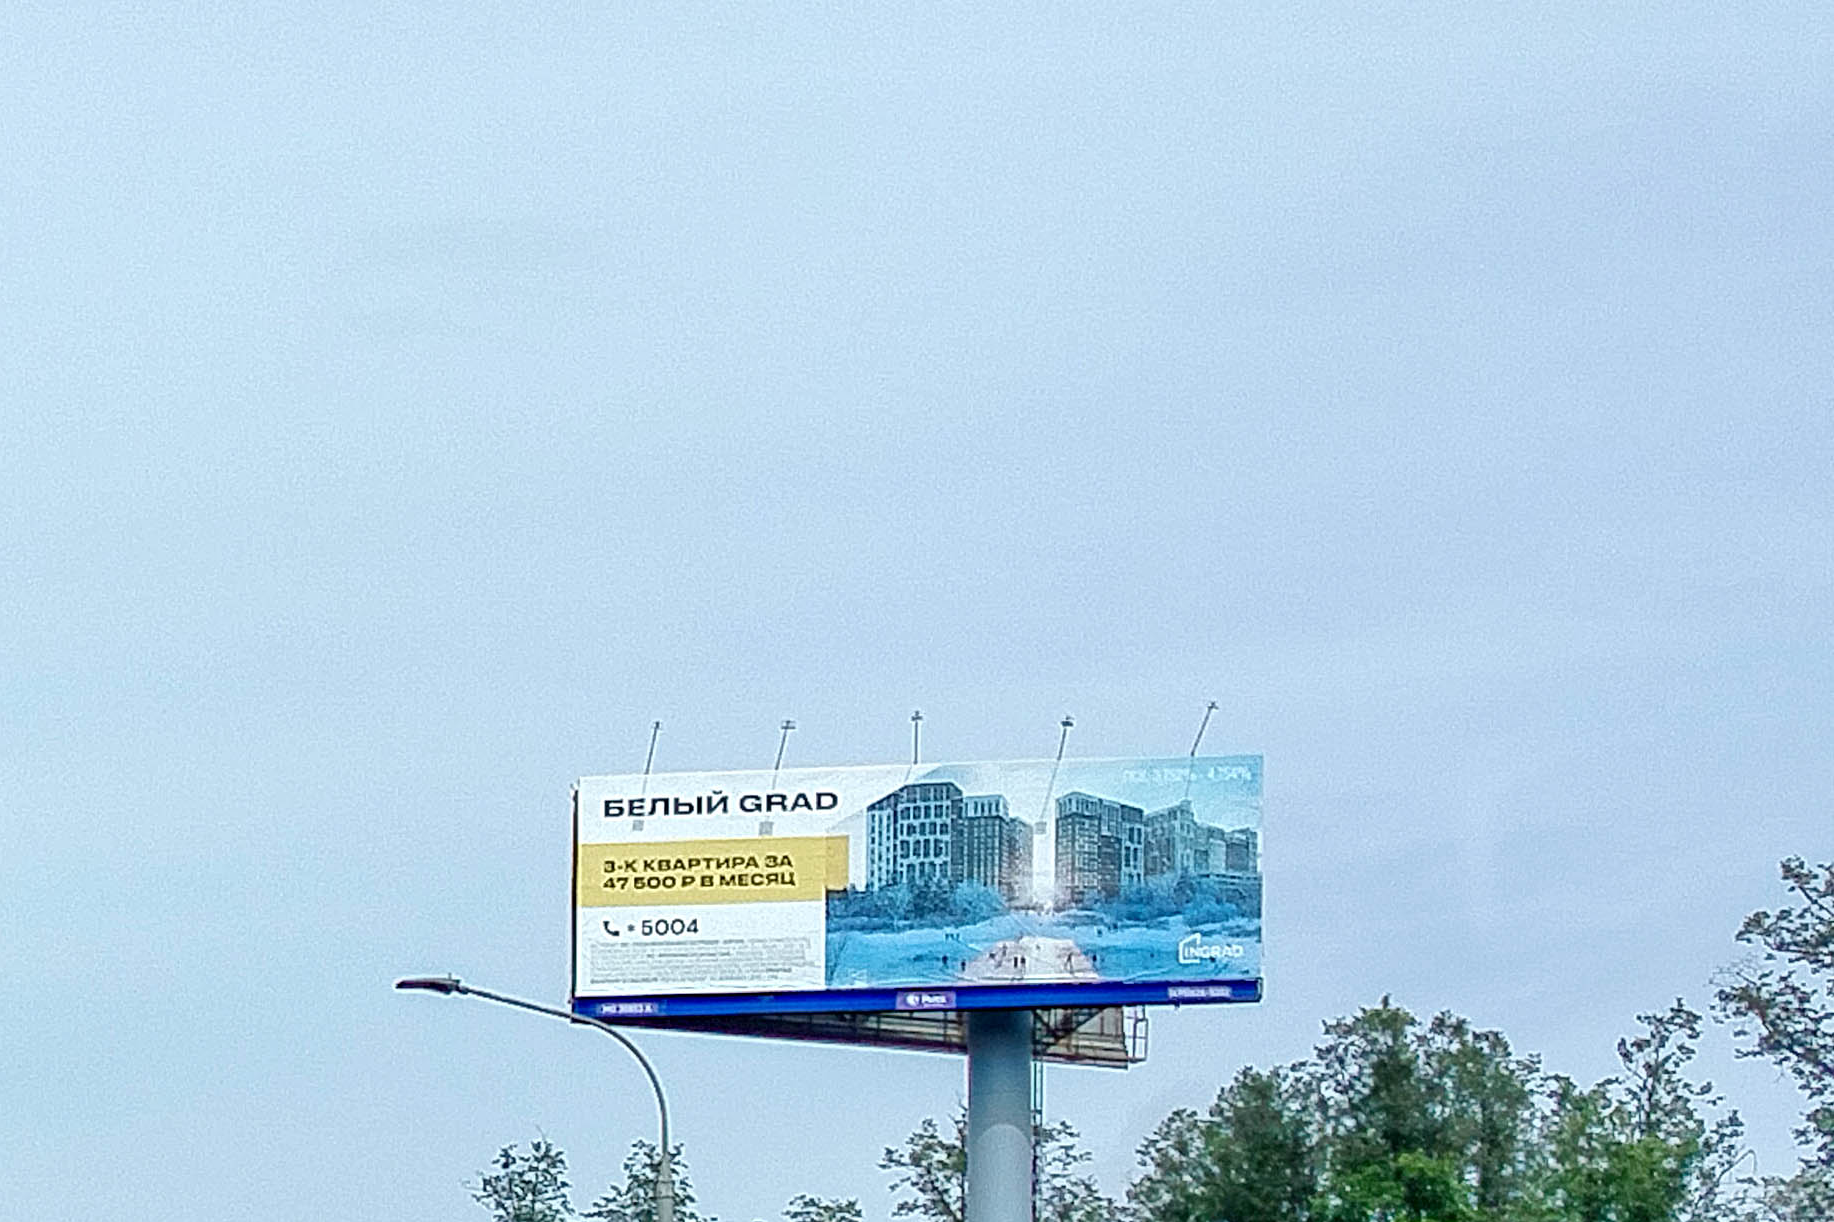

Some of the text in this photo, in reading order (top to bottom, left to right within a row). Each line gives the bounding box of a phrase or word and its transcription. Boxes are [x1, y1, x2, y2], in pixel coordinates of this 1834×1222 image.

[604, 790, 839, 817] БЕЛЫЙ GRAD
[643, 856, 759, 871] КВАРТИРА
[765, 855, 793, 868] ЗА
[603, 877, 628, 889] 47
[633, 876, 676, 889] 500
[719, 872, 795, 887] МЕСЯЦ
